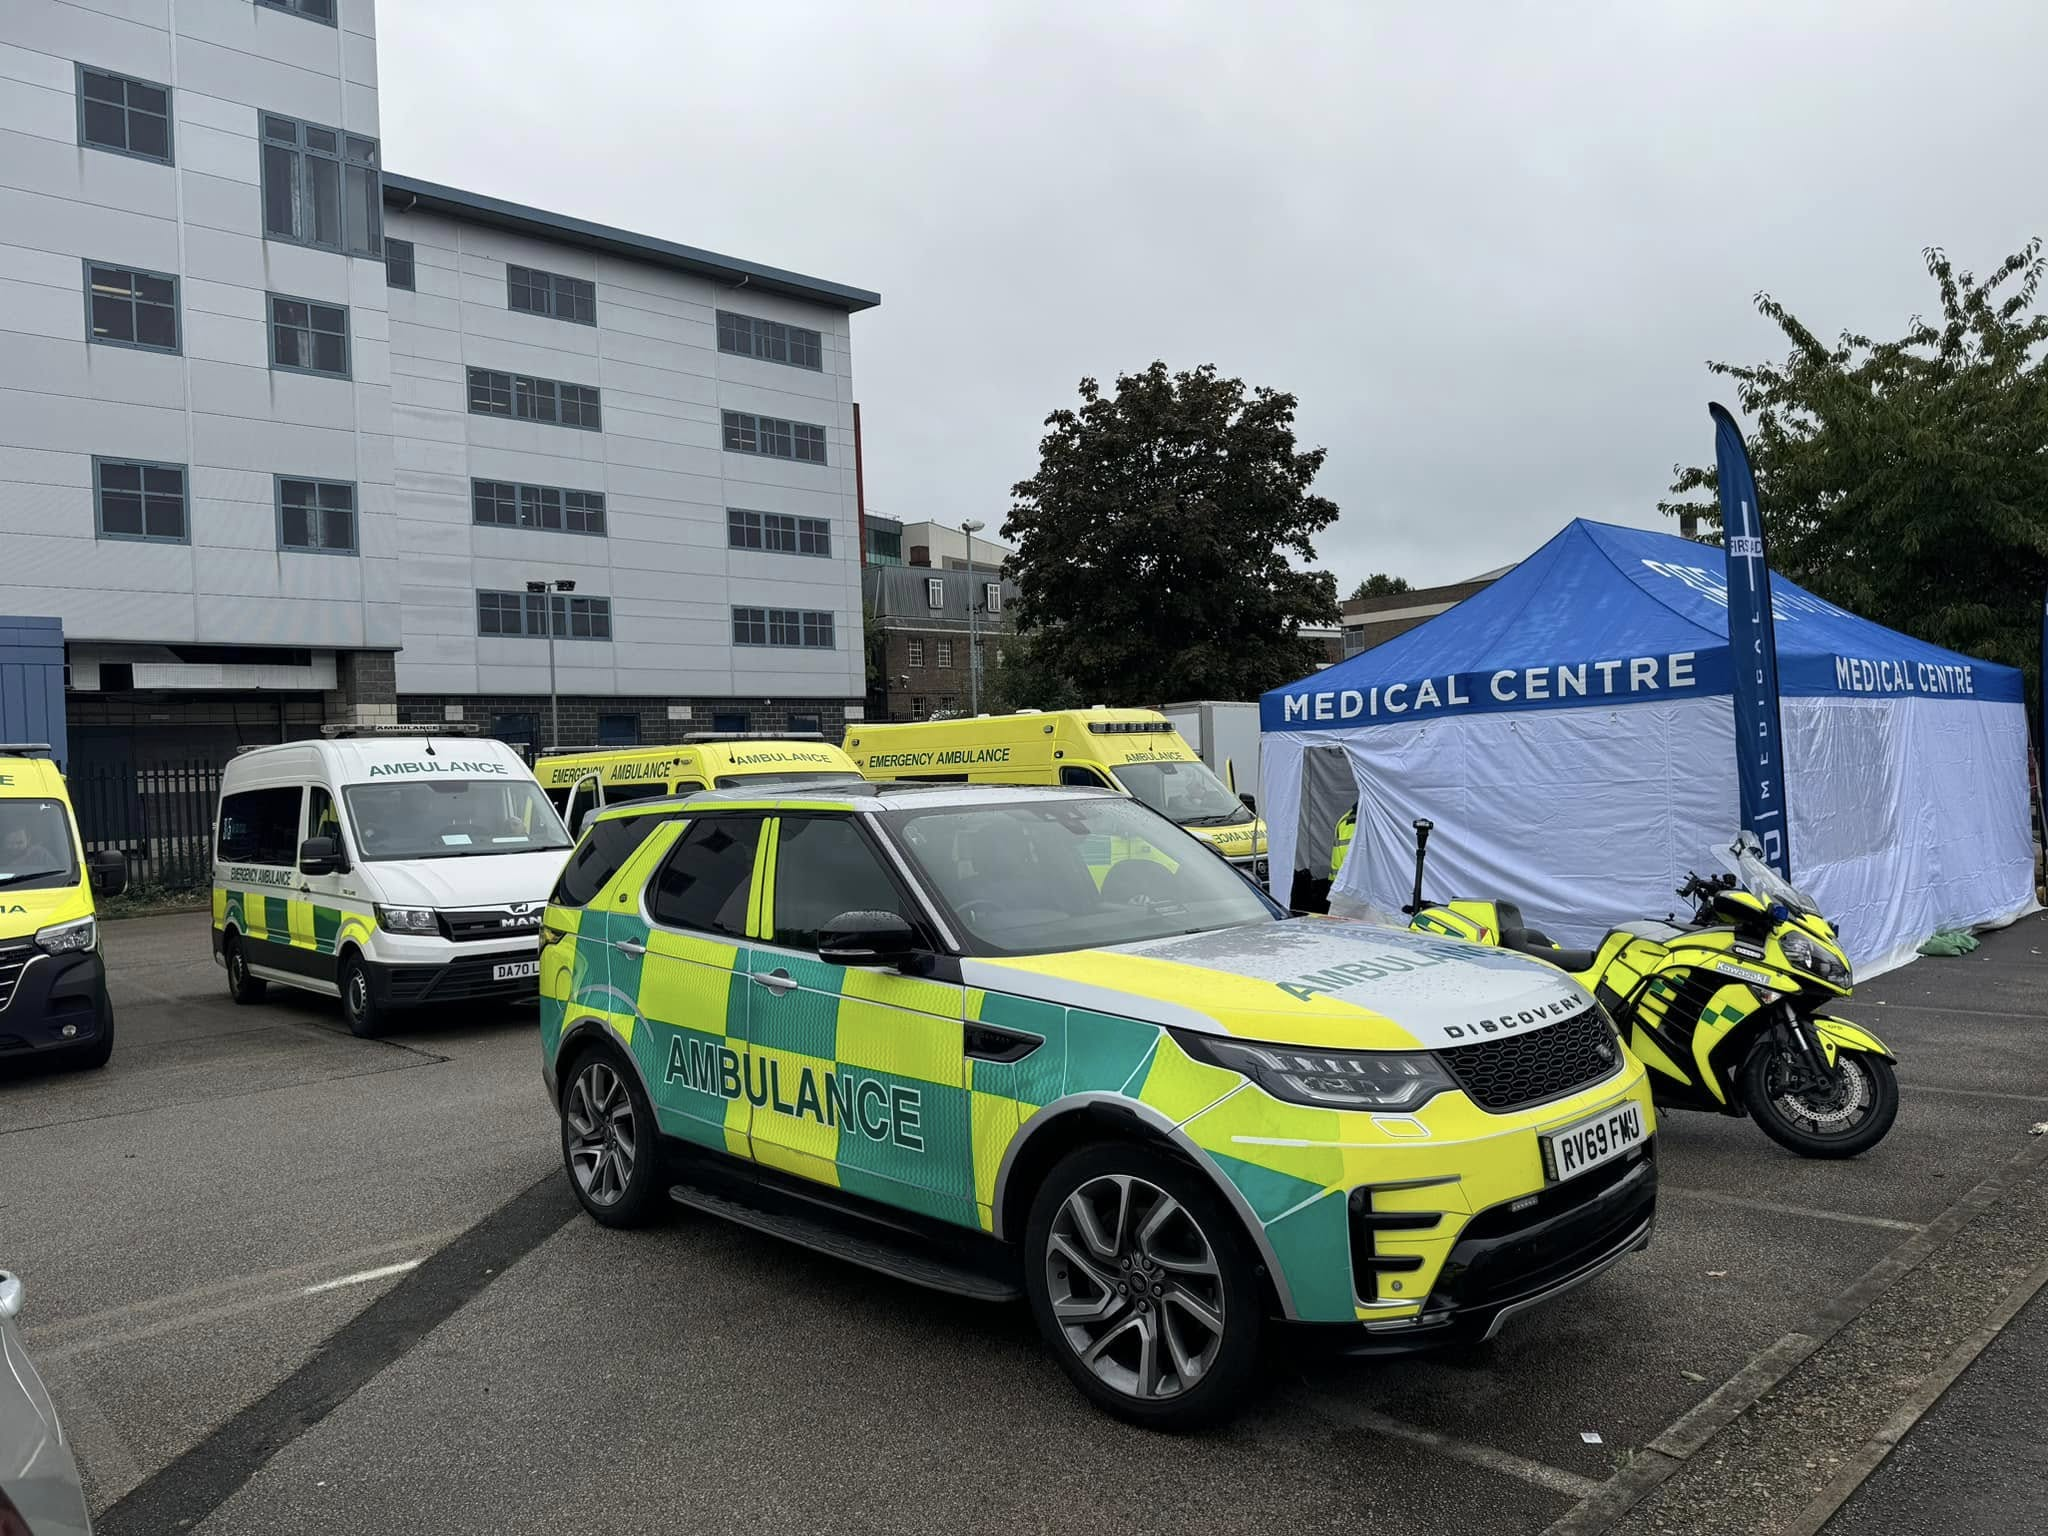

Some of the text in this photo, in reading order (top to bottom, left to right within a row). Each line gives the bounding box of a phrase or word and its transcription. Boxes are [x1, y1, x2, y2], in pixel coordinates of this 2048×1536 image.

[1835, 655, 1974, 694] MEDICAL CENTRE
[1284, 652, 1696, 722] MEDICAL CENTRE
[737, 752, 832, 766] AMBULANCE
[869, 748, 1010, 768] EMERGENCY AMBULANCE
[1125, 751, 1185, 763] AMBULANCE
[369, 761, 508, 777] AMBULANCE
[610, 760, 671, 781] AMBULANCE
[230, 867, 292, 886] EMERGENCY AMBULANCE
[501, 916, 542, 928] MAN
[498, 963, 529, 978] DA70
[1276, 944, 1504, 1003] AMBULAN
[1716, 961, 1770, 985] Kawasaki
[1443, 993, 1583, 1039] DISCOVERY
[664, 1034, 925, 1153] AMBULANCE
[1561, 1107, 1640, 1172] RV69 FMU
